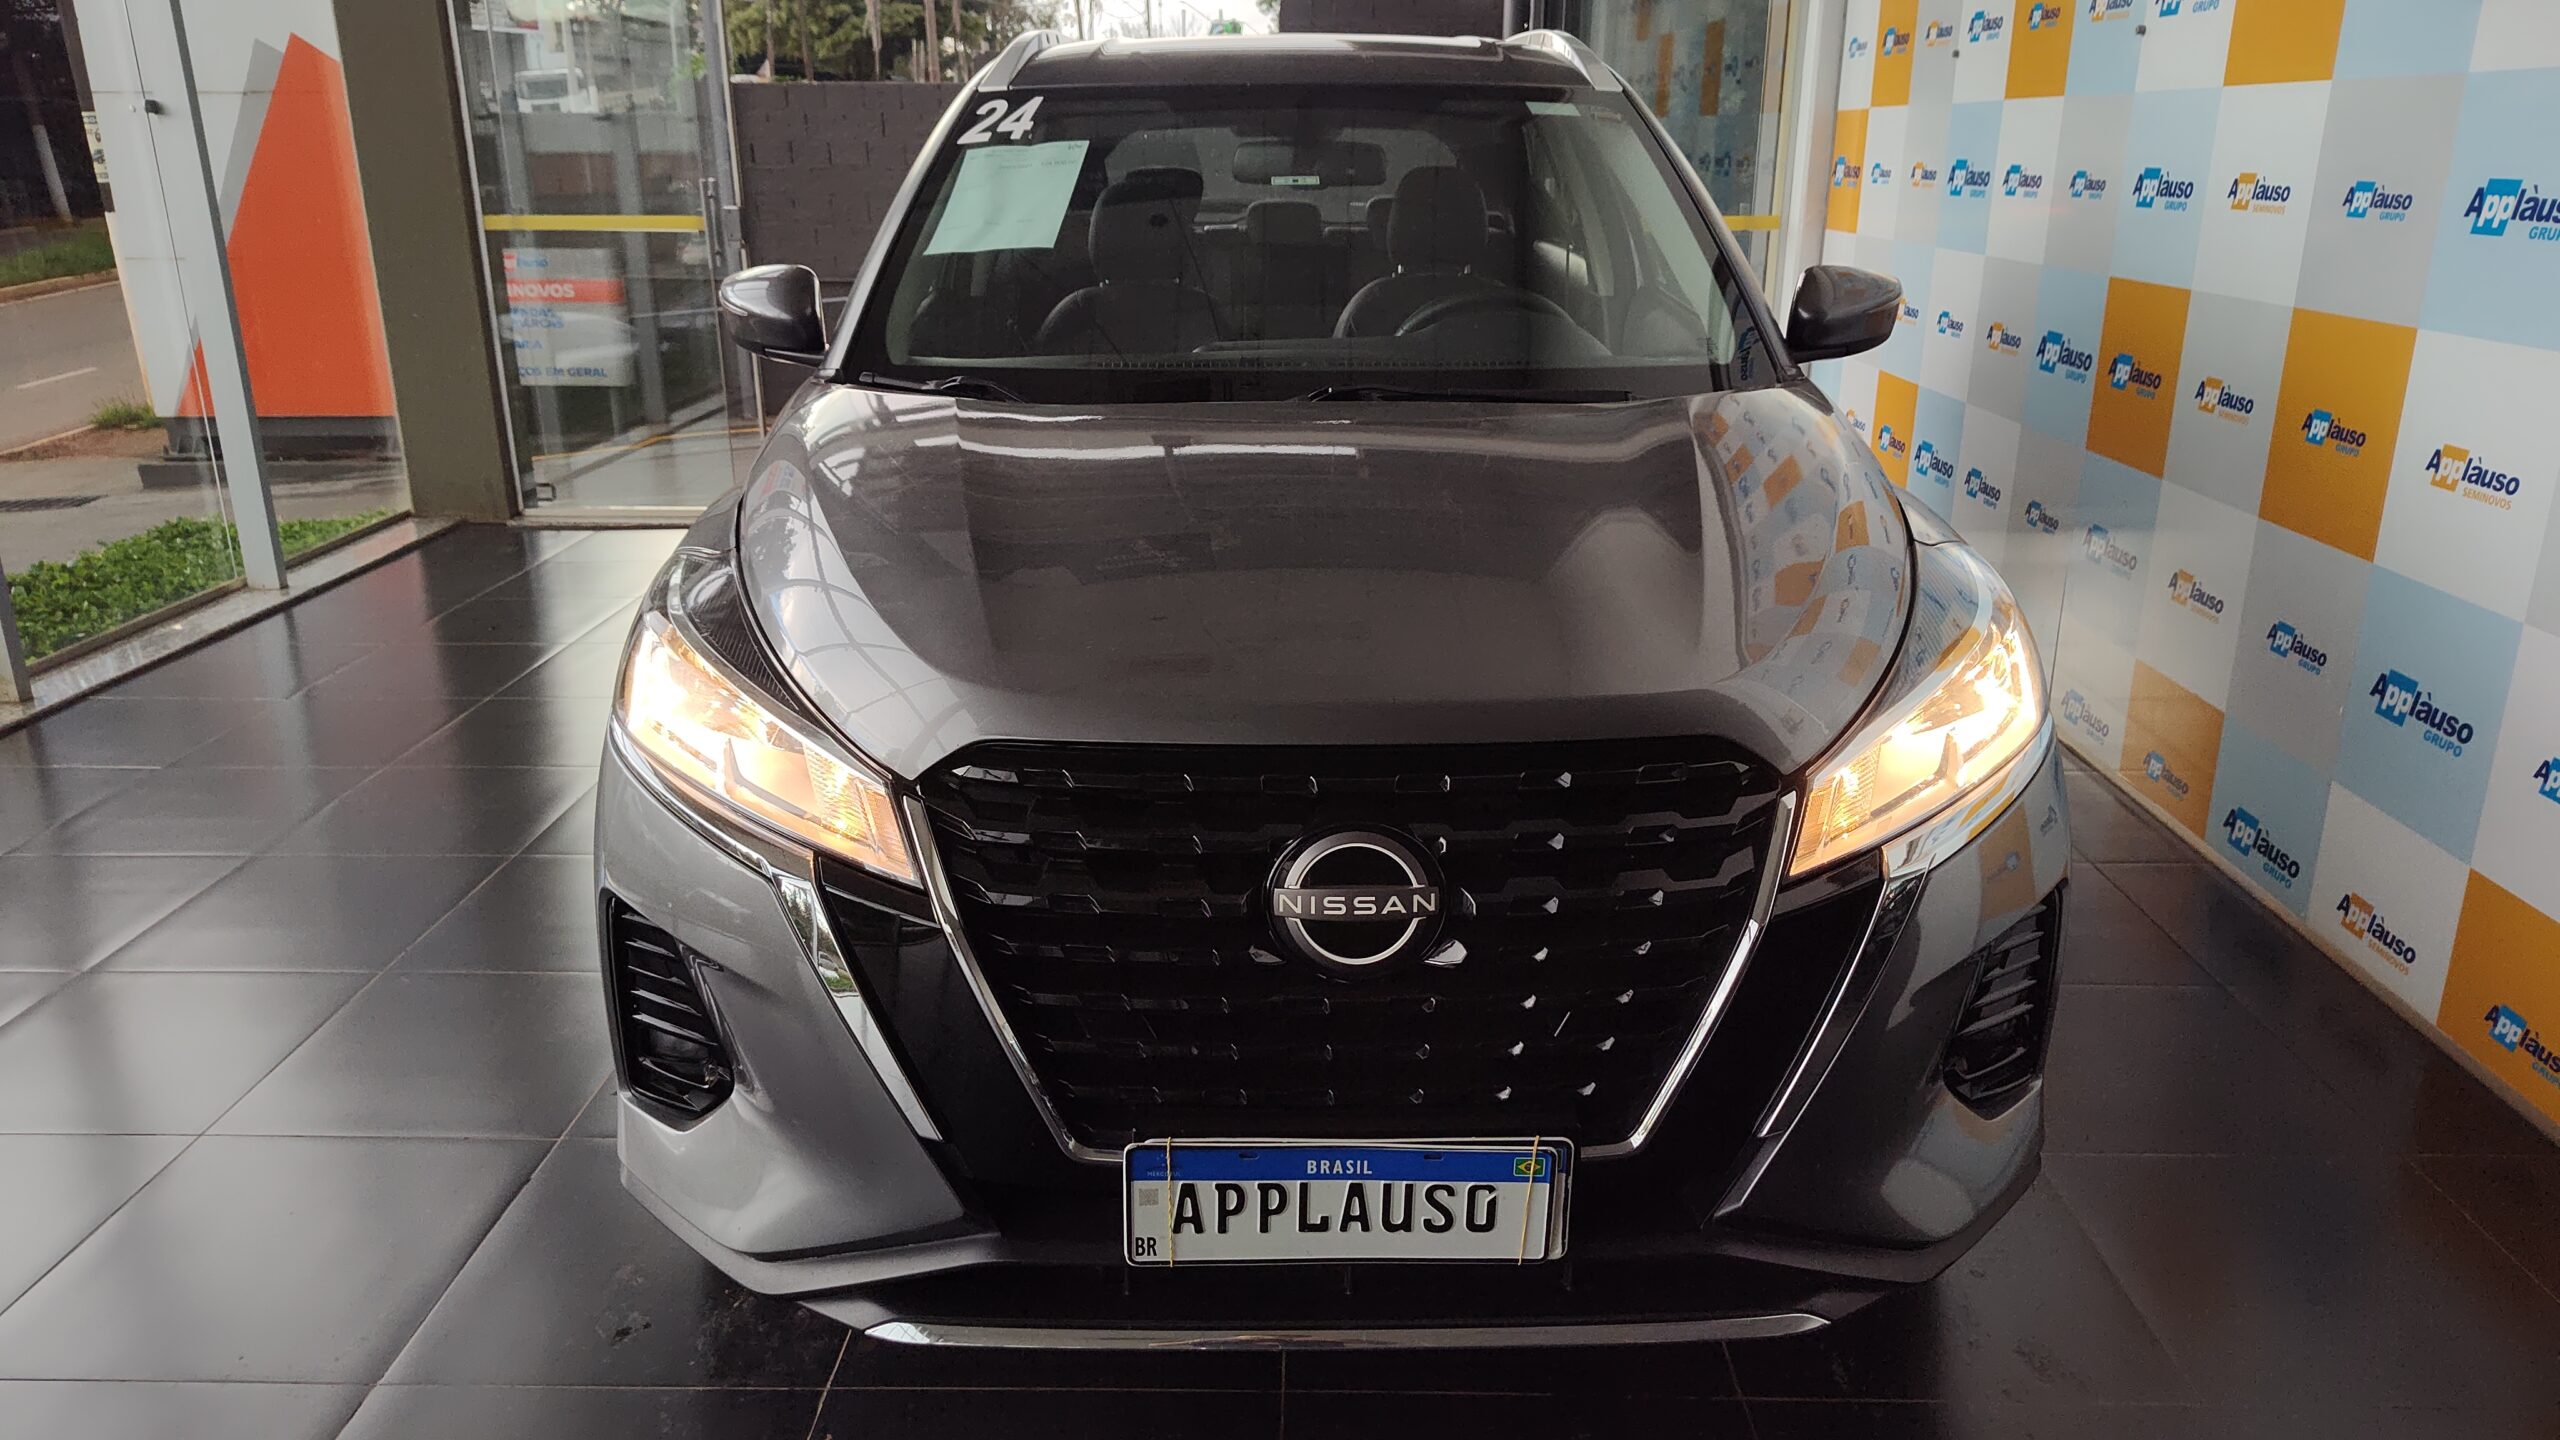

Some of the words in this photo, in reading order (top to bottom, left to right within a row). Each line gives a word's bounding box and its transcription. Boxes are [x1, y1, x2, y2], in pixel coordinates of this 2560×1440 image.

[957, 97, 1044, 145] 24
[2379, 211, 2405, 222] GRUPO
[2462, 487, 2512, 510] SEMINOVOS
[2423, 729, 2463, 757] GRUPO
[2263, 862, 2293, 889] GRUPO
[1278, 892, 1436, 915] NISSAN
[1306, 1159, 1373, 1175] BRASIL
[1171, 1181, 1499, 1235] APPLAUSO
[1135, 1236, 1158, 1257] BR
